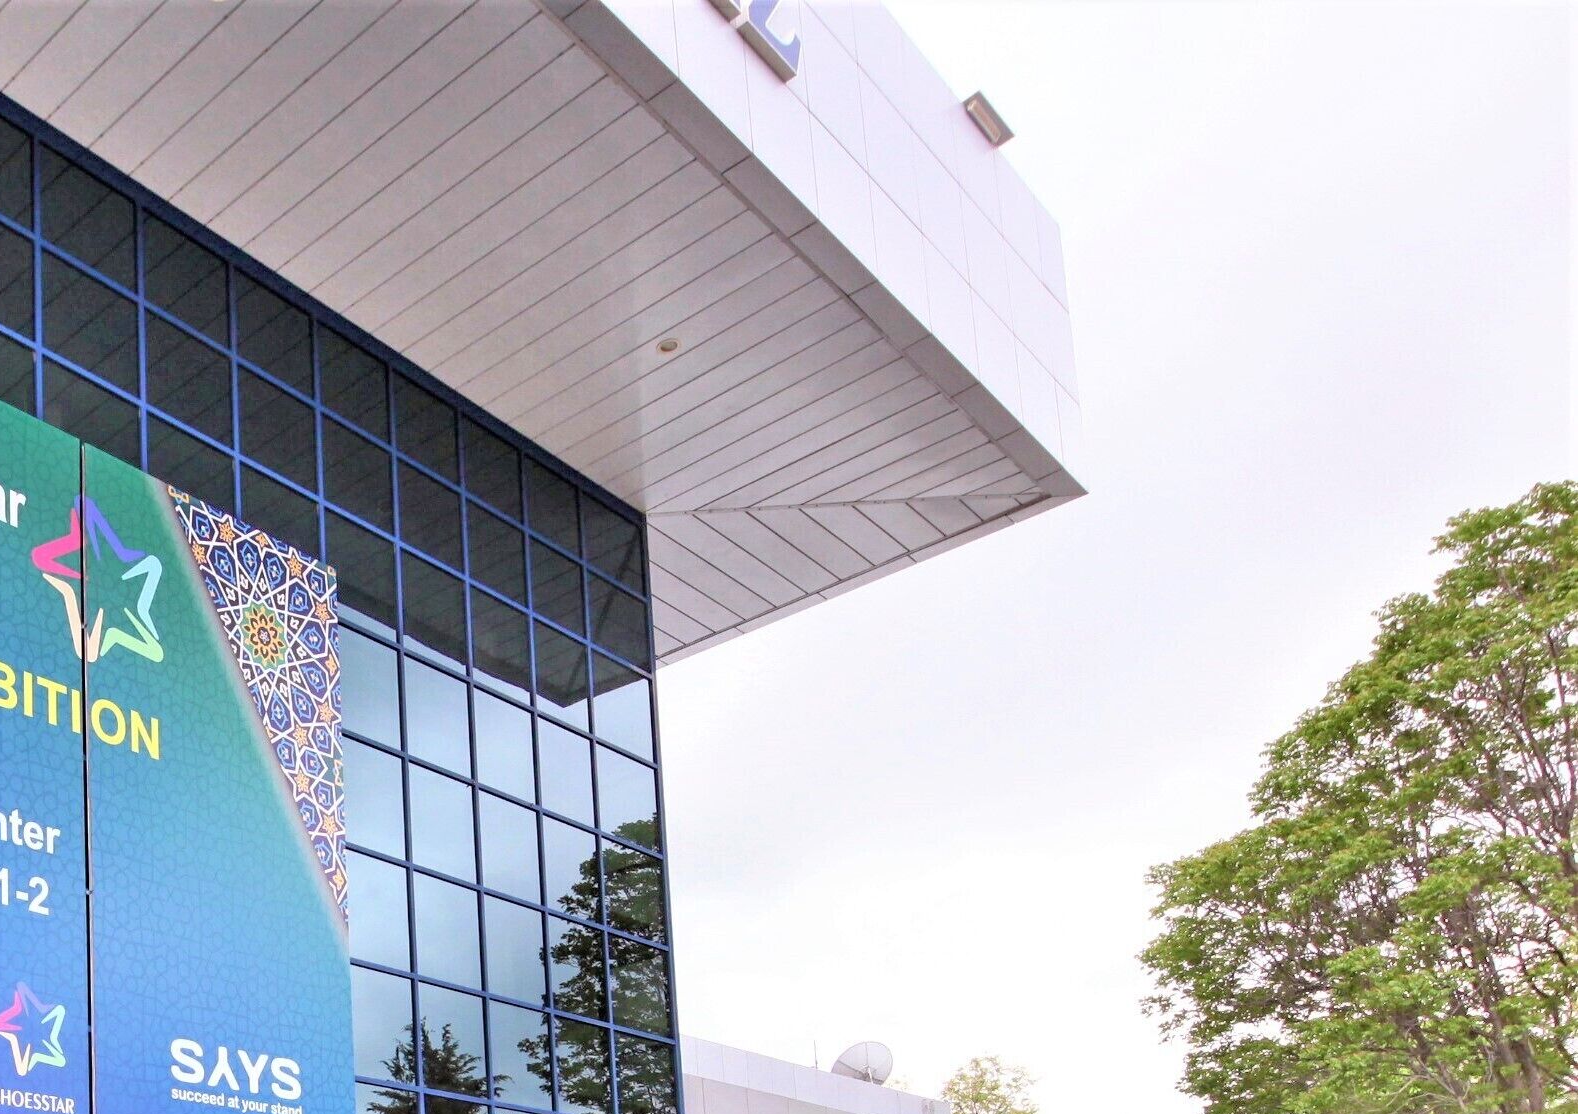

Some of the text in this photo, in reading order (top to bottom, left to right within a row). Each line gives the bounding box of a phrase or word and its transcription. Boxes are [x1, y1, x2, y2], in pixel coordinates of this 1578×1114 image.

[171, 1088, 225, 1107] succeed
[227, 1095, 241, 1109] at
[241, 1099, 269, 1114] your
